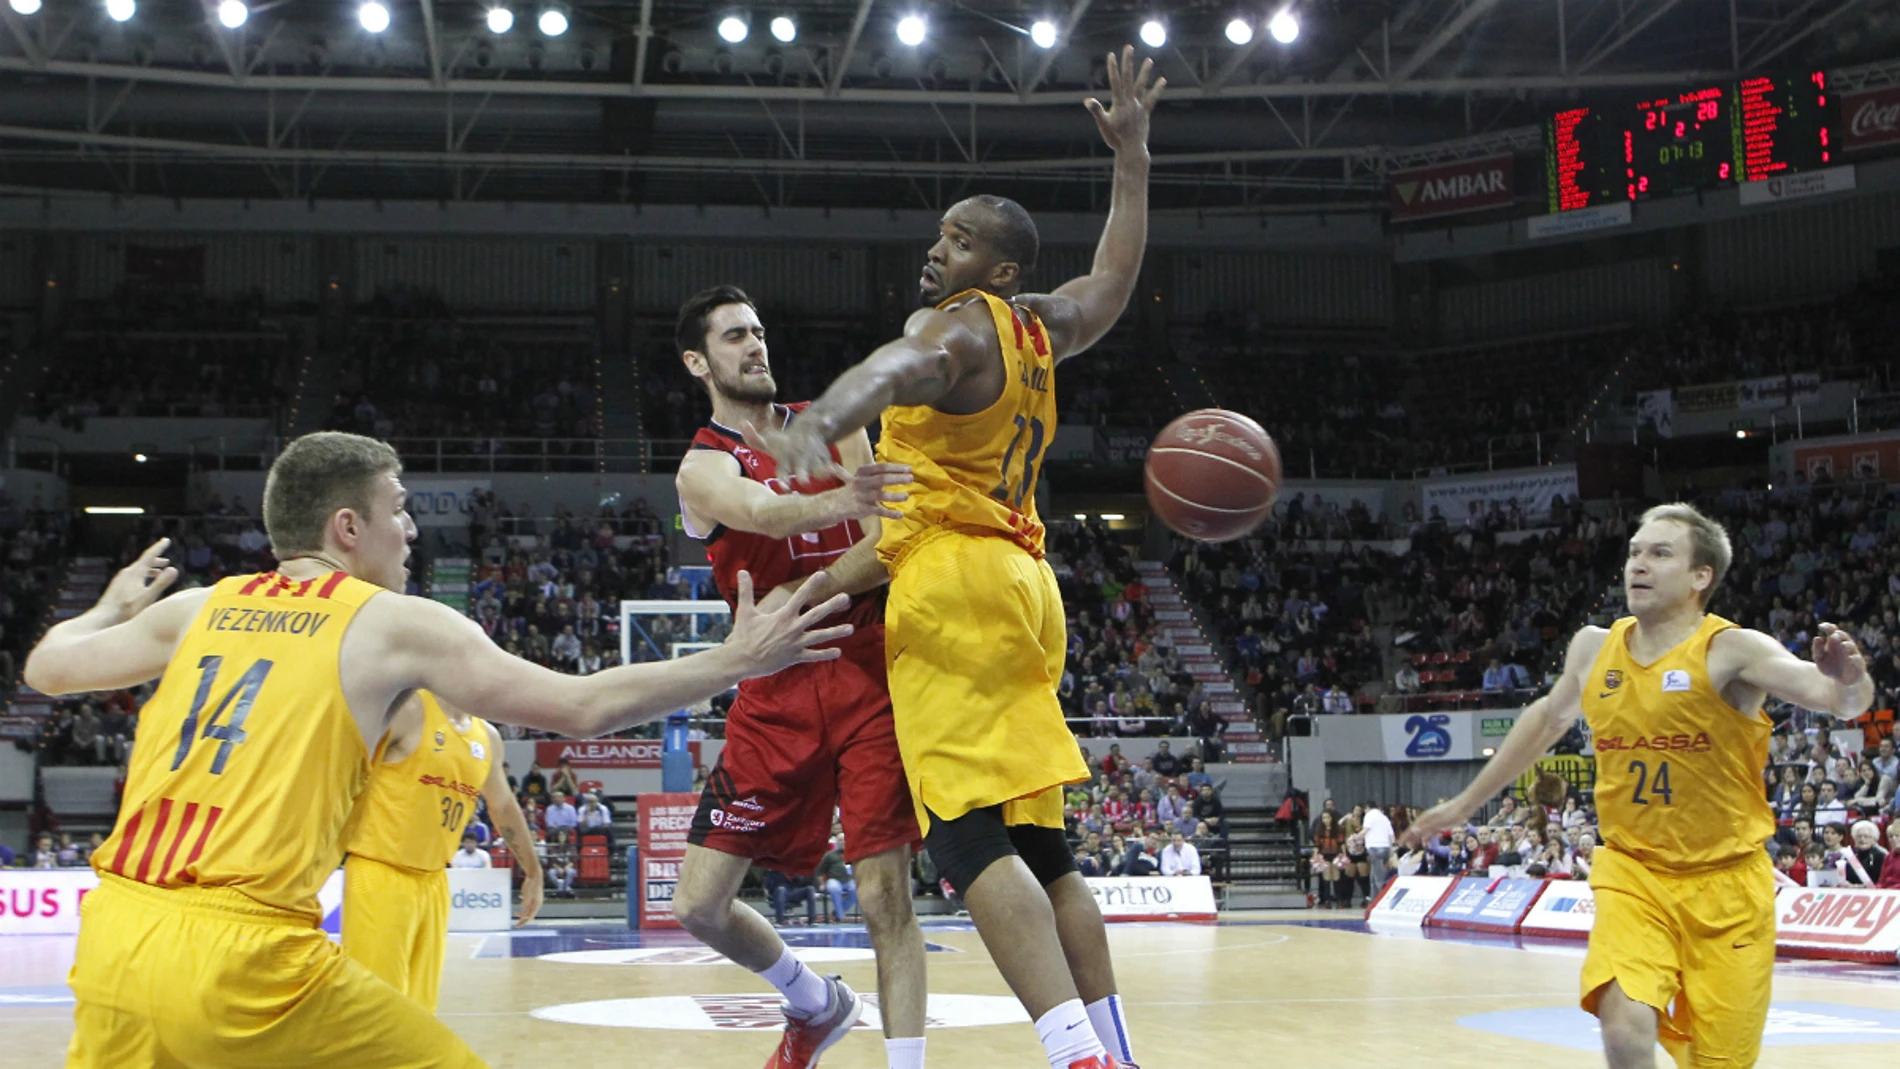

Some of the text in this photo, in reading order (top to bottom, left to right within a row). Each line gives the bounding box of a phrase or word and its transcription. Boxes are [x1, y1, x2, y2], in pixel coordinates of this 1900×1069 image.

[1697, 100, 1719, 121] 28
[1645, 111, 1667, 131] 21
[1674, 120, 1686, 138] 2
[1719, 161, 1731, 179] 2
[1420, 169, 1507, 202] AMBAR
[1637, 175, 1649, 193] 2
[207, 607, 331, 638] VEZENKOV
[170, 655, 275, 776] 14
[1405, 714, 1451, 757] 25
[1617, 732, 1711, 751] LASSA
[561, 745, 662, 759] ALEJANDR
[1628, 759, 1673, 806] 24
[441, 796, 464, 832] 30
[648, 883, 676, 899] DE
